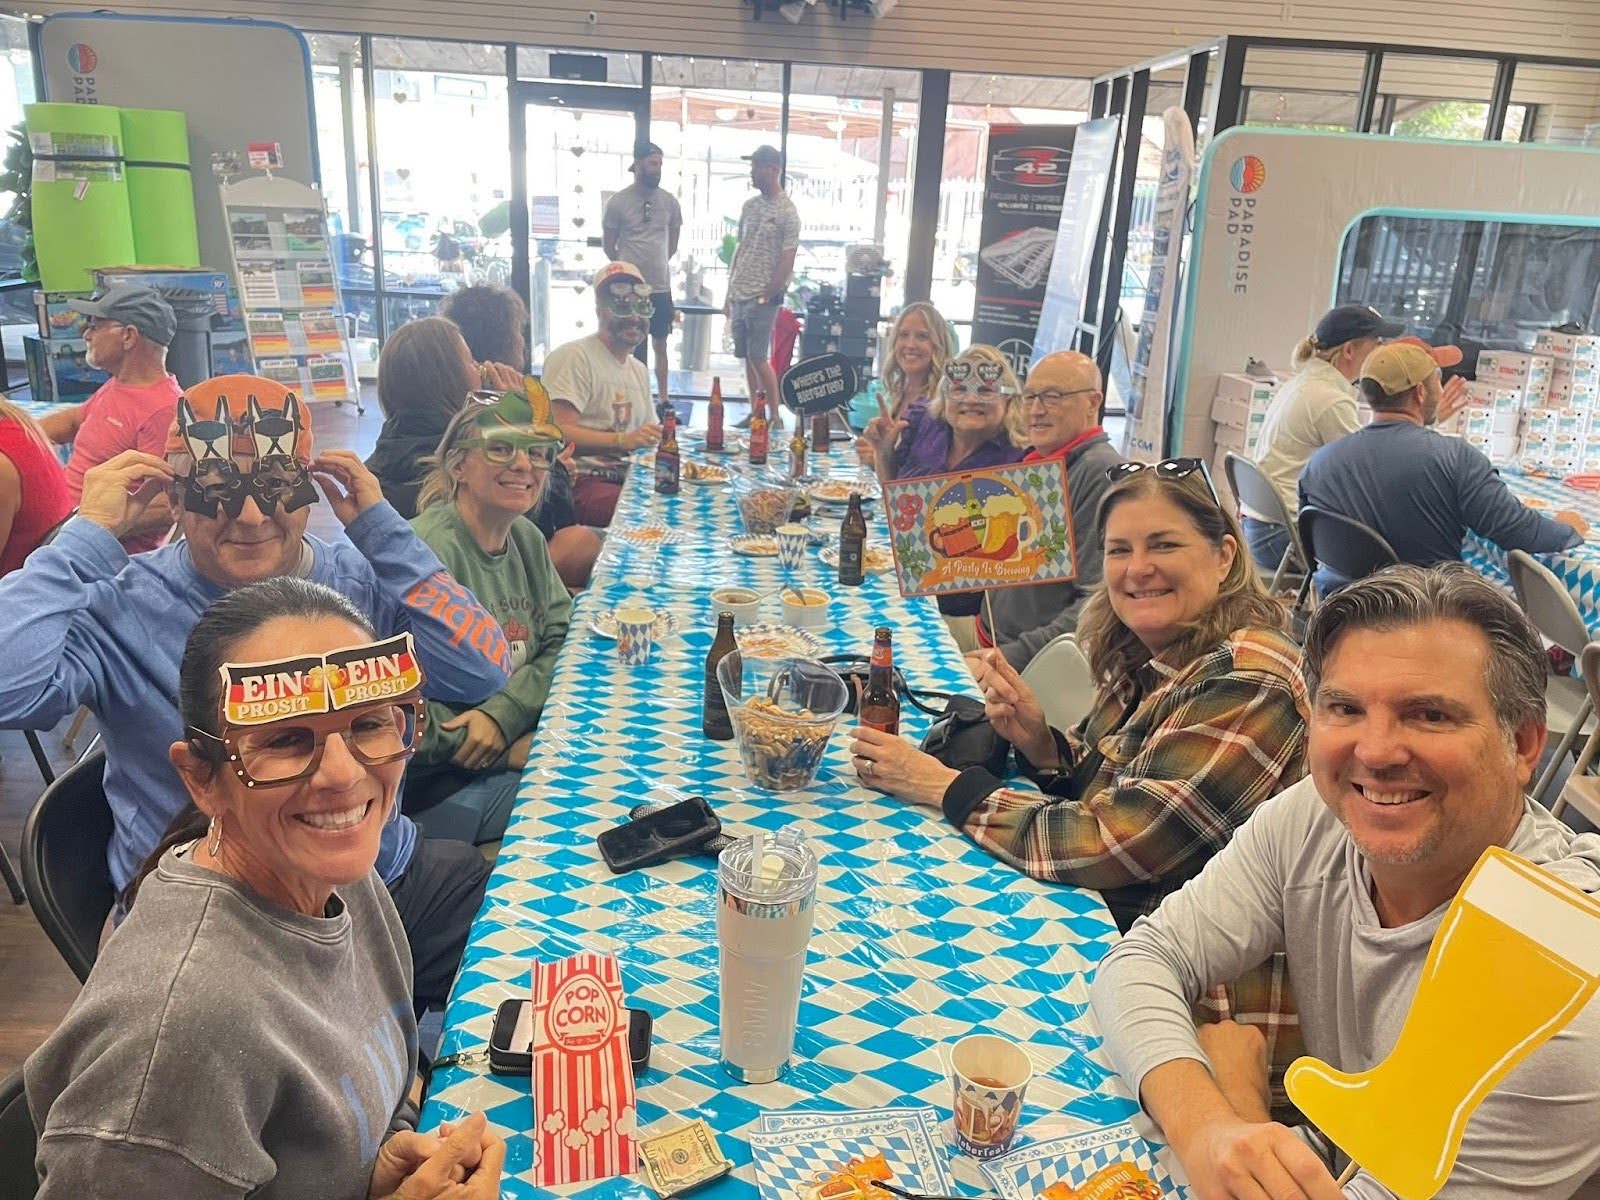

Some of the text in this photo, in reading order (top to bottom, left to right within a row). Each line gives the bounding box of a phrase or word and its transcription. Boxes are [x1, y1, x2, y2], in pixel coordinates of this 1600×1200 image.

[1013, 162, 1058, 175] 42
[1226, 198, 1242, 234] PAD
[1234, 198, 1256, 294] PARADISE
[241, 654, 401, 703] EIN EIN
[236, 677, 408, 720] PROSIT PROSIT
[565, 986, 600, 1005] POP
[556, 1005, 607, 1027] CORN
[955, 1129, 1005, 1157] toberfest
